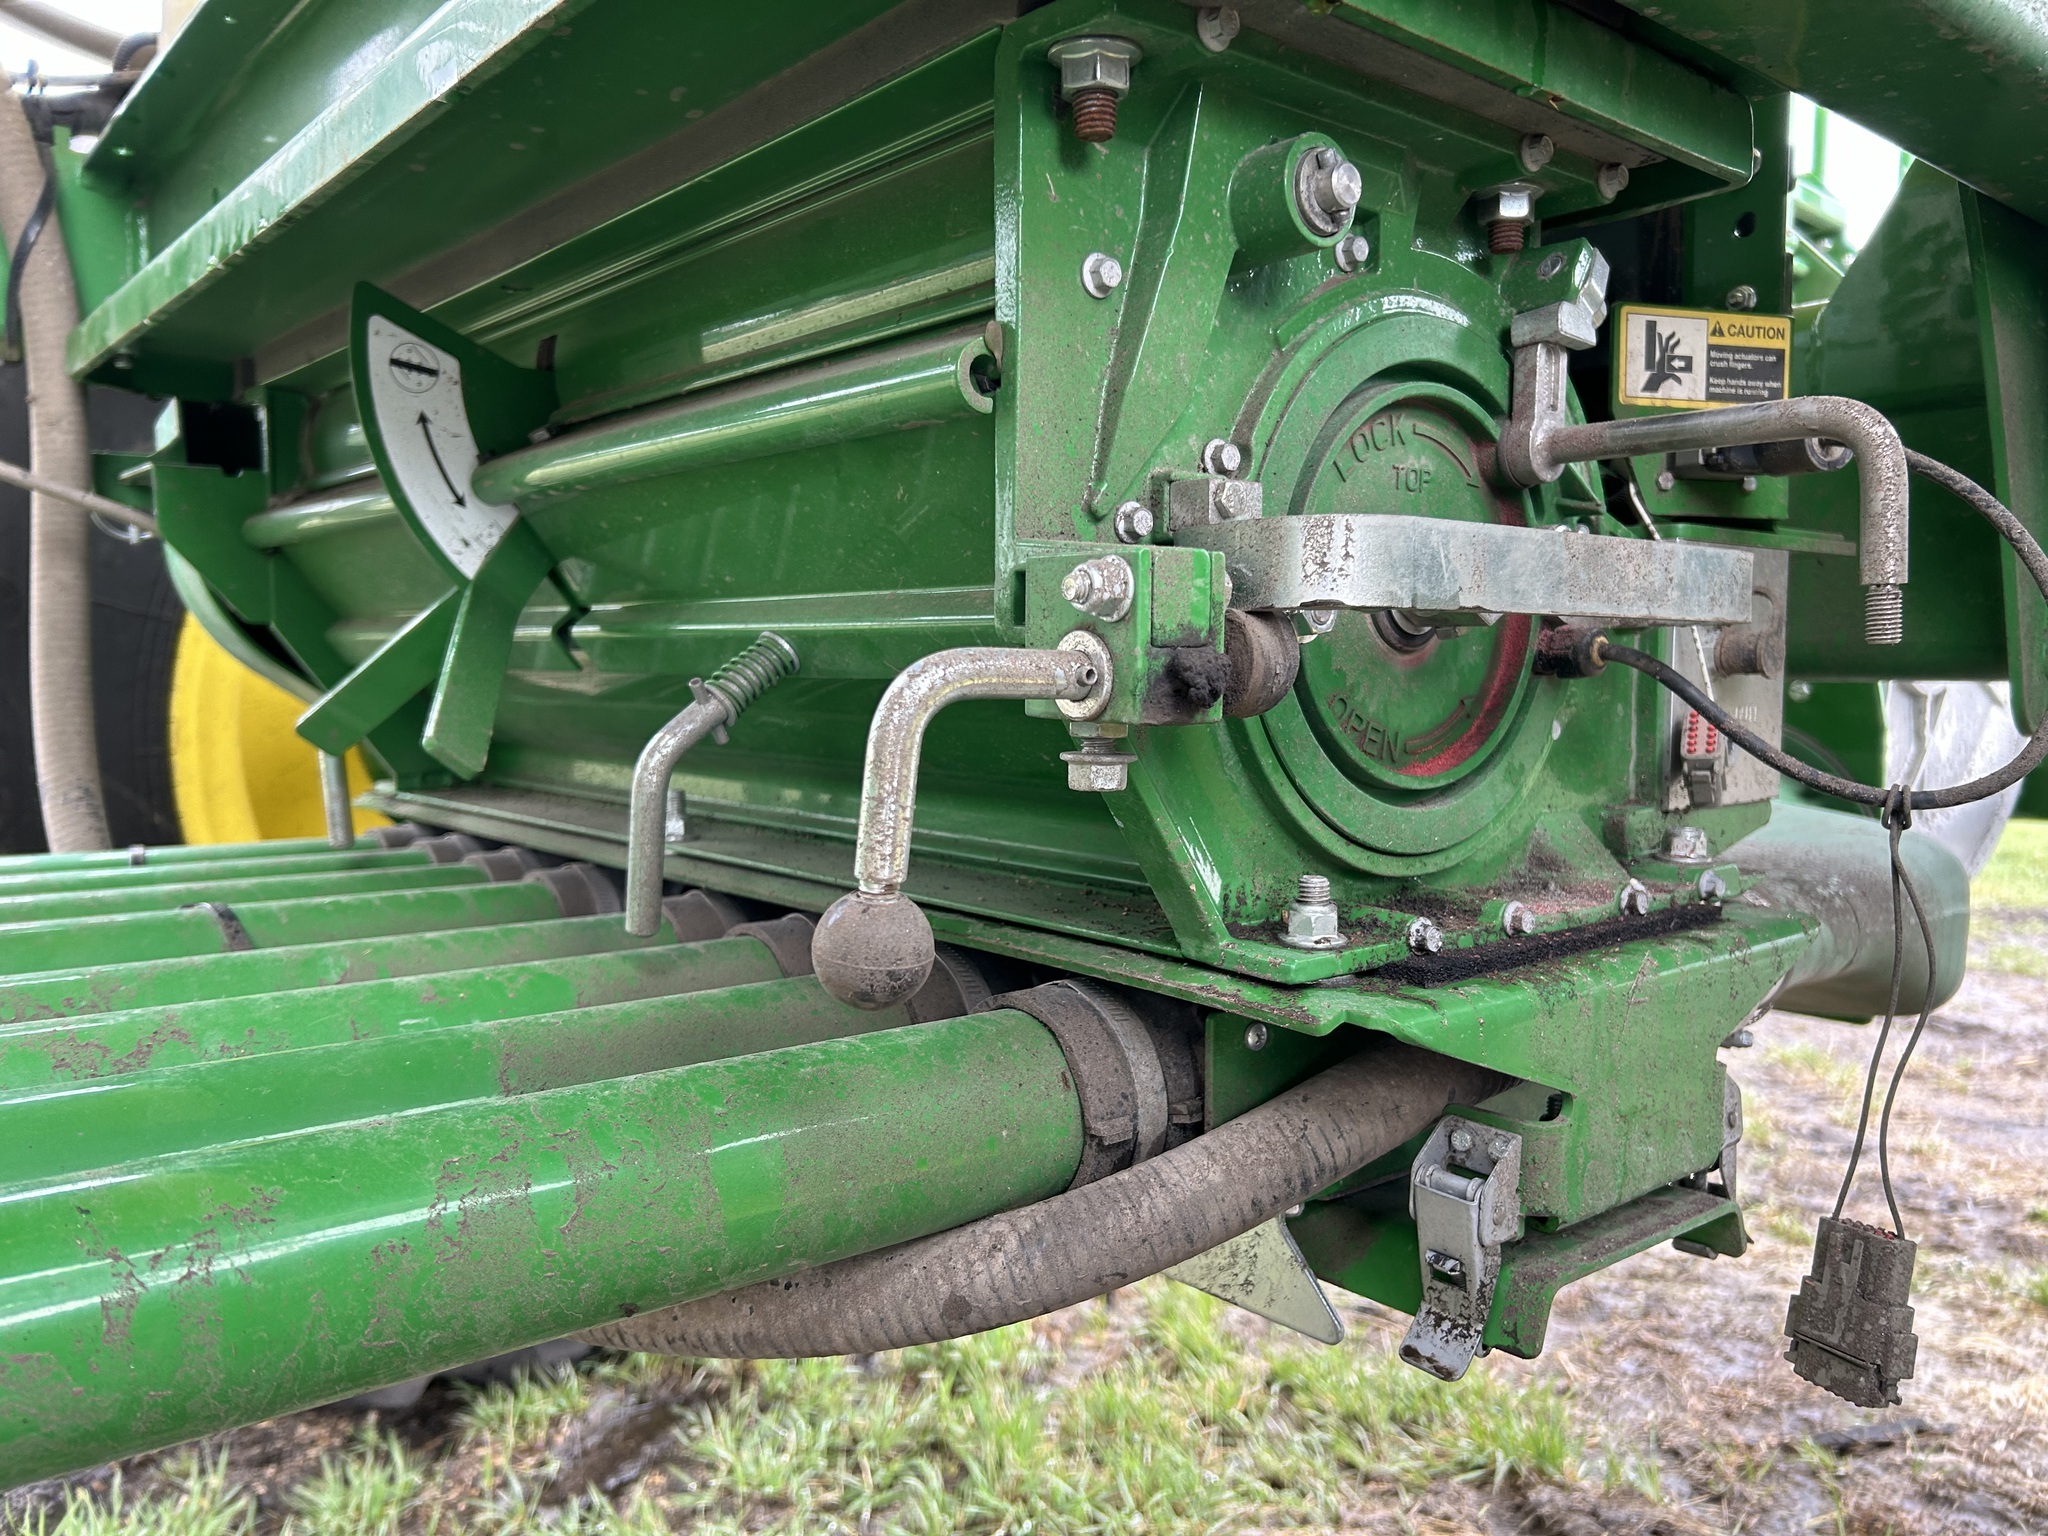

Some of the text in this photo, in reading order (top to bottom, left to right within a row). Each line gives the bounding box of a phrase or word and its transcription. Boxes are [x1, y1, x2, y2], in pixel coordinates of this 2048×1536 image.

[1727, 324, 1785, 340] CAUTION
[1709, 350, 1777, 362] Moving actuators can
[1709, 360, 1728, 368] crush
[1709, 376, 1781, 388] Keep hands away when
[1709, 386, 1736, 395] machine
[1333, 413, 1406, 483] LOCK
[1392, 464, 1431, 494] TOP
[1328, 693, 1401, 764] OPEN
